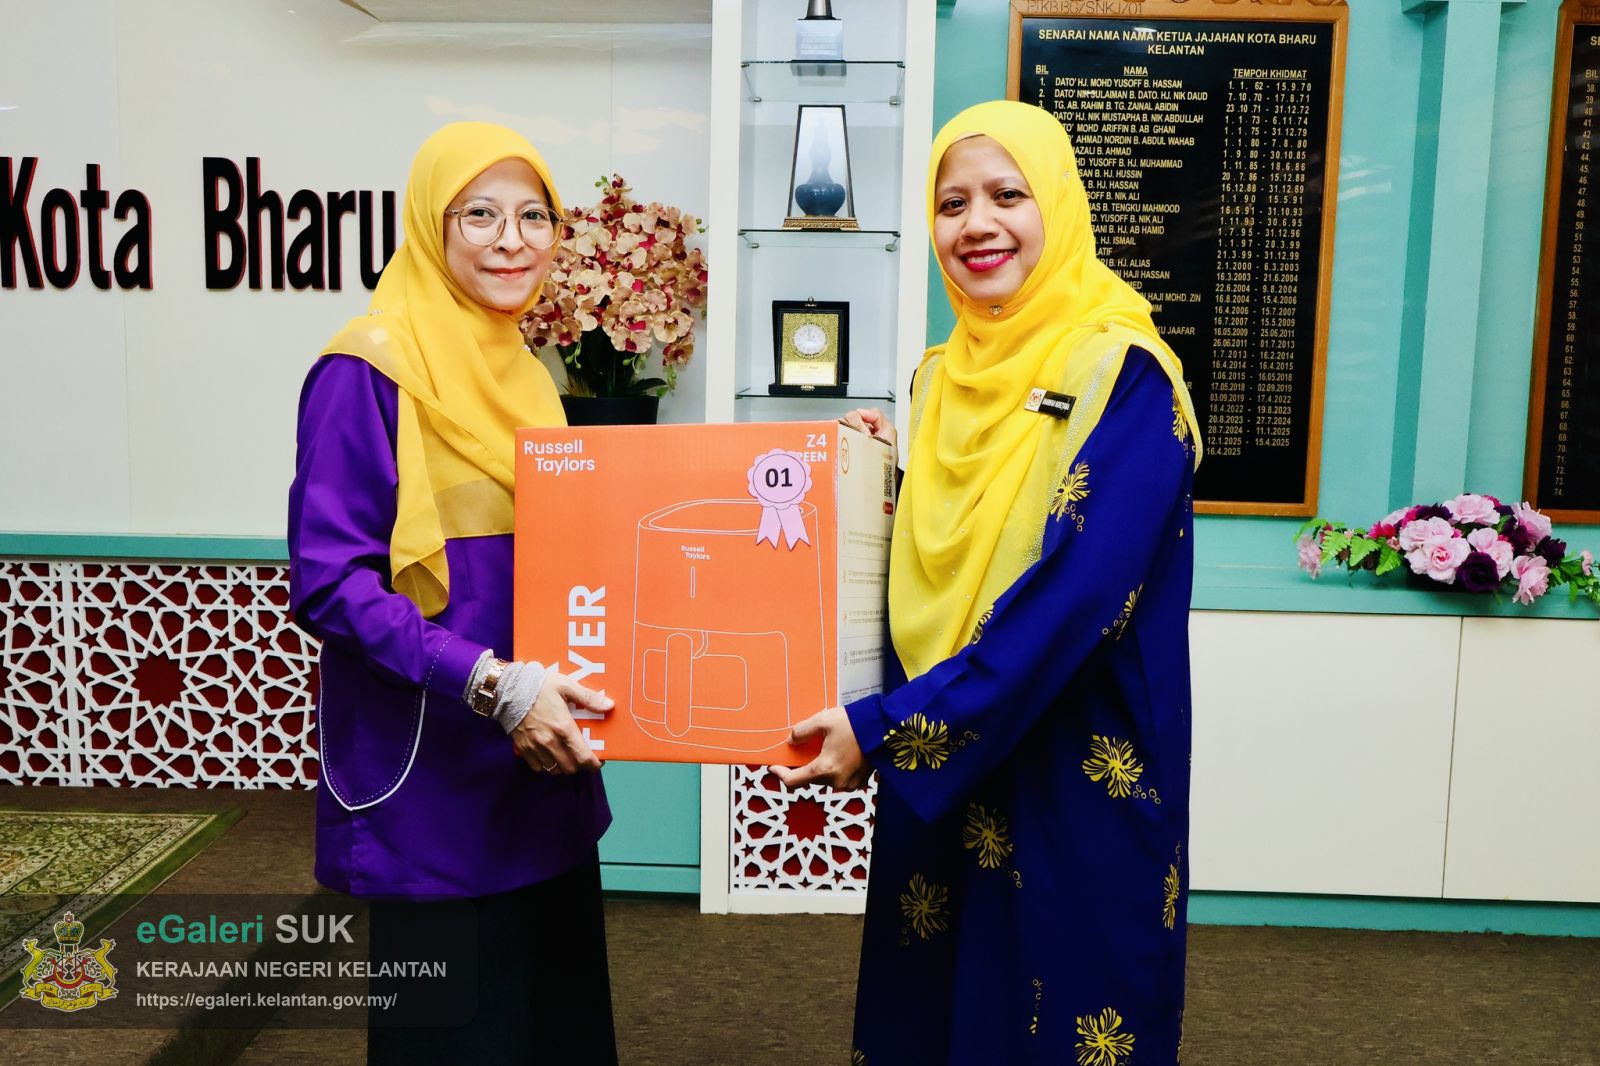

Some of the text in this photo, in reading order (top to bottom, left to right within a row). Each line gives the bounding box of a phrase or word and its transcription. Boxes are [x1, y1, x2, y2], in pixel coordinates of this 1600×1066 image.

[1039, 30, 1316, 44] SENARAI NAMA NAMA KETUA JAJAHAN KOTA BHARU
[1148, 45, 1204, 55] KELANTAN
[1036, 65, 1307, 78] BIL NAMA TEMPOH KHIDMAT
[1586, 69, 1598, 78] BIL
[1040, 77, 1045, 86] 1.
[1056, 77, 1076, 86] DATO'
[1078, 78, 1088, 86] HJ.
[1090, 78, 1112, 87] MOHD
[1114, 79, 1142, 87] YUSOFF
[1153, 80, 1182, 88] HASSAN
[1039, 89, 1045, 97] 2.
[1055, 89, 1075, 98] DATO'
[1077, 90, 1089, 98] NIK
[1091, 90, 1127, 98] SULAIMAN
[1187, 92, 1208, 100] DAUD
[1054, 101, 1065, 109] TG.
[1067, 101, 1079, 109] AB.
[1081, 101, 1104, 109] RAHIM
[1115, 102, 1126, 110] TG.
[1128, 102, 1153, 110] ZAINAL
[1155, 103, 1178, 111] ABIDIN
[1275, 106, 1309, 114] 31.12.72
[1075, 112, 1086, 120] HJ.
[1088, 112, 1100, 120] NIK
[1102, 113, 1140, 121] MUSTAPHA
[1164, 114, 1204, 123] ABDULLAH
[1077, 124, 1098, 132] MOHD
[1102, 124, 1129, 132] ARIFFIN
[1131, 125, 1137, 133] B.
[1139, 125, 1149, 133] AB
[1153, 125, 1175, 133] GHANI
[1076, 135, 1102, 143] AHMAD
[1104, 136, 1131, 144] NORDIN
[1134, 136, 1140, 144] B.
[1142, 136, 1166, 145] ABDUL
[1168, 137, 1194, 146] WAHAB
[1074, 146, 1095, 154] AZALI
[1097, 147, 1104, 155] B.
[1106, 147, 1131, 155] AHMAD
[1089, 158, 1117, 167] YUSOFF
[1119, 158, 1125, 167] B.
[1128, 159, 1138, 167] HJ.
[1140, 159, 1182, 168] MUHAMMAD
[1079, 169, 1093, 177] SAN
[1095, 169, 1101, 177] B.
[1104, 169, 1114, 178] HJ.
[1116, 170, 1142, 178] HUSSIN
[1088, 180, 1095, 188] B.
[1097, 180, 1107, 189] HJ.
[1109, 181, 1139, 189] HASSAN
[1087, 191, 1104, 200] SOFF
[1106, 192, 1113, 200] B.
[1115, 192, 1126, 200] NIK
[1103, 203, 1109, 211] B.
[1111, 203, 1140, 212] TENGKU
[1142, 204, 1180, 212] MAHMOOD
[1100, 214, 1128, 222] YUSOFF
[1130, 214, 1136, 223] B.
[1139, 215, 1151, 223] NIK
[1152, 215, 1163, 223] ALI
[0, 157, 396, 290] Kota Bharu
[1109, 225, 1115, 233] B.
[1118, 225, 1128, 234] HJ.
[1130, 226, 1140, 234] AB
[1142, 226, 1164, 234] HAMID
[1101, 236, 1136, 245] HJ. ISMAIL
[1130, 259, 1150, 267] ALIAS
[1124, 270, 1139, 278] HAJI
[1141, 271, 1170, 279] HASSAN
[1165, 293, 1187, 302] MOHD.
[1190, 294, 1201, 302] ZIN
[1168, 327, 1195, 335] JAAFAR
[806, 434, 827, 448] Z4
[524, 439, 583, 455] Russell
[535, 457, 595, 476] Taylors
[765, 468, 792, 488] 01
[686, 552, 710, 560] Taylors
